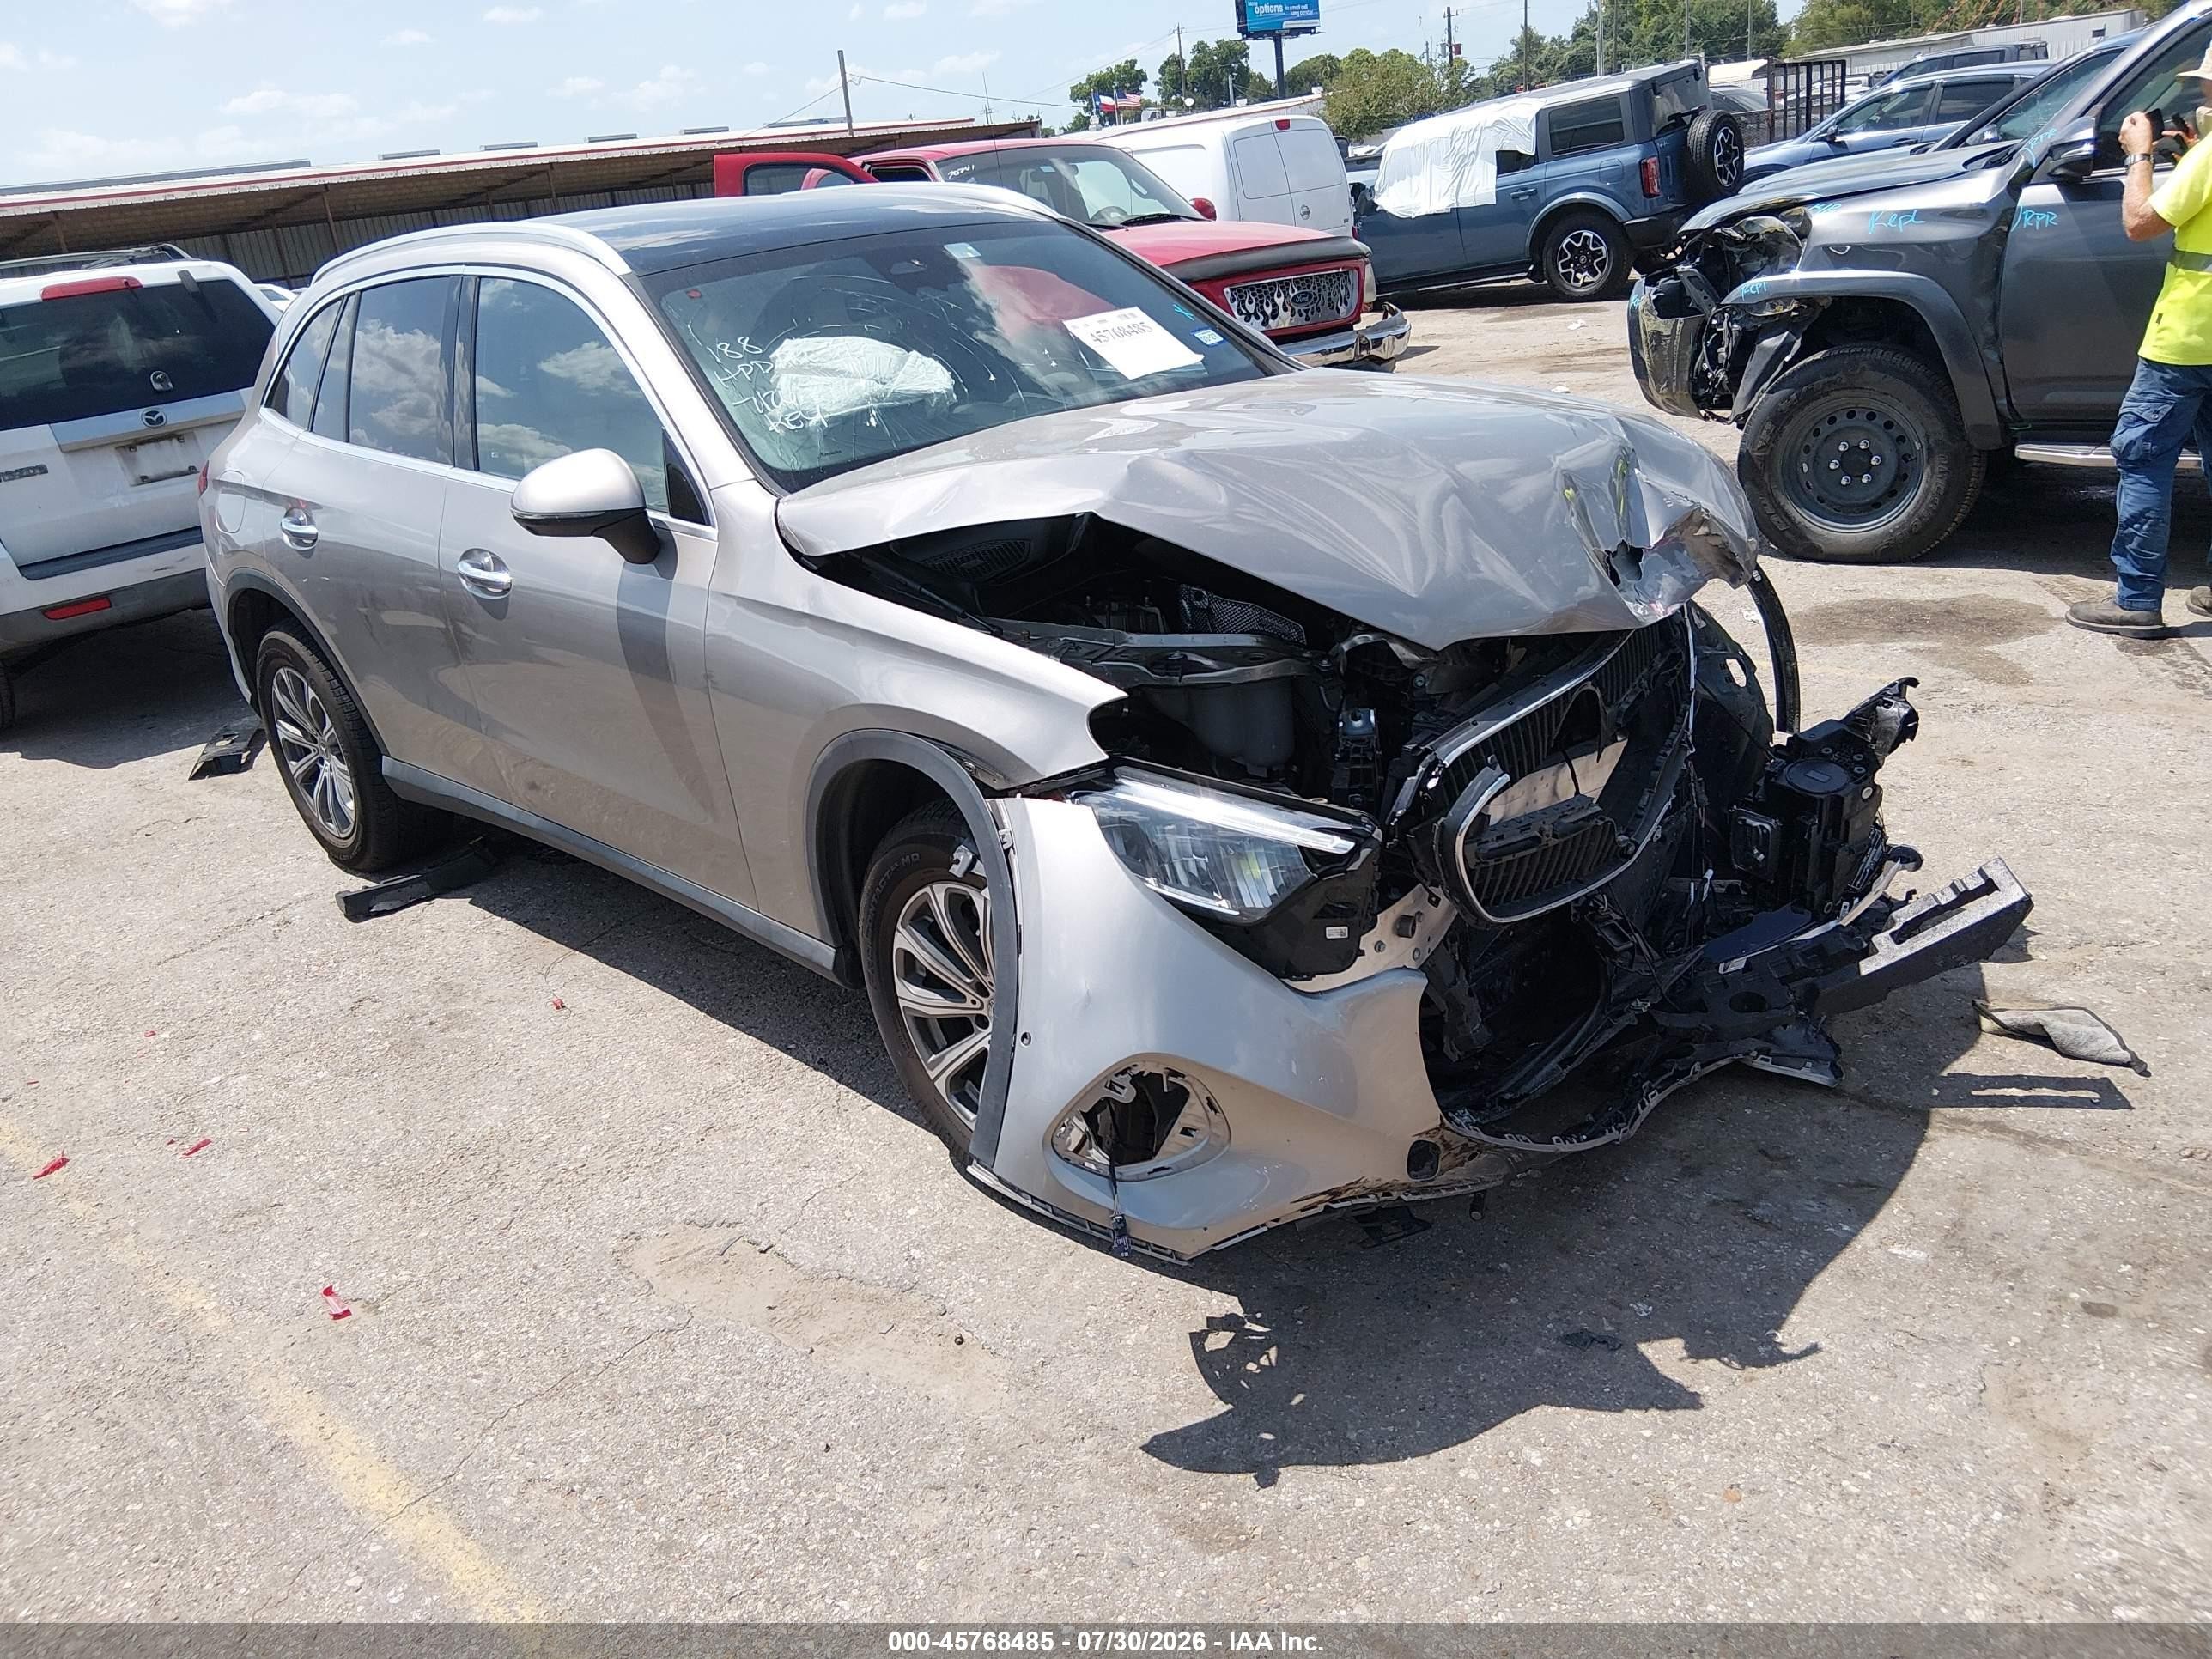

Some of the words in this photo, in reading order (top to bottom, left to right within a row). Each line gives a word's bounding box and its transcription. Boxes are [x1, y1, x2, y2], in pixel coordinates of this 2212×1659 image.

[1255, 3, 1284, 16] options
[1295, 293, 1310, 303] Ford
[1090, 321, 1154, 344] 45768485
[707, 336, 763, 363] 188
[714, 360, 775, 390] HPD
